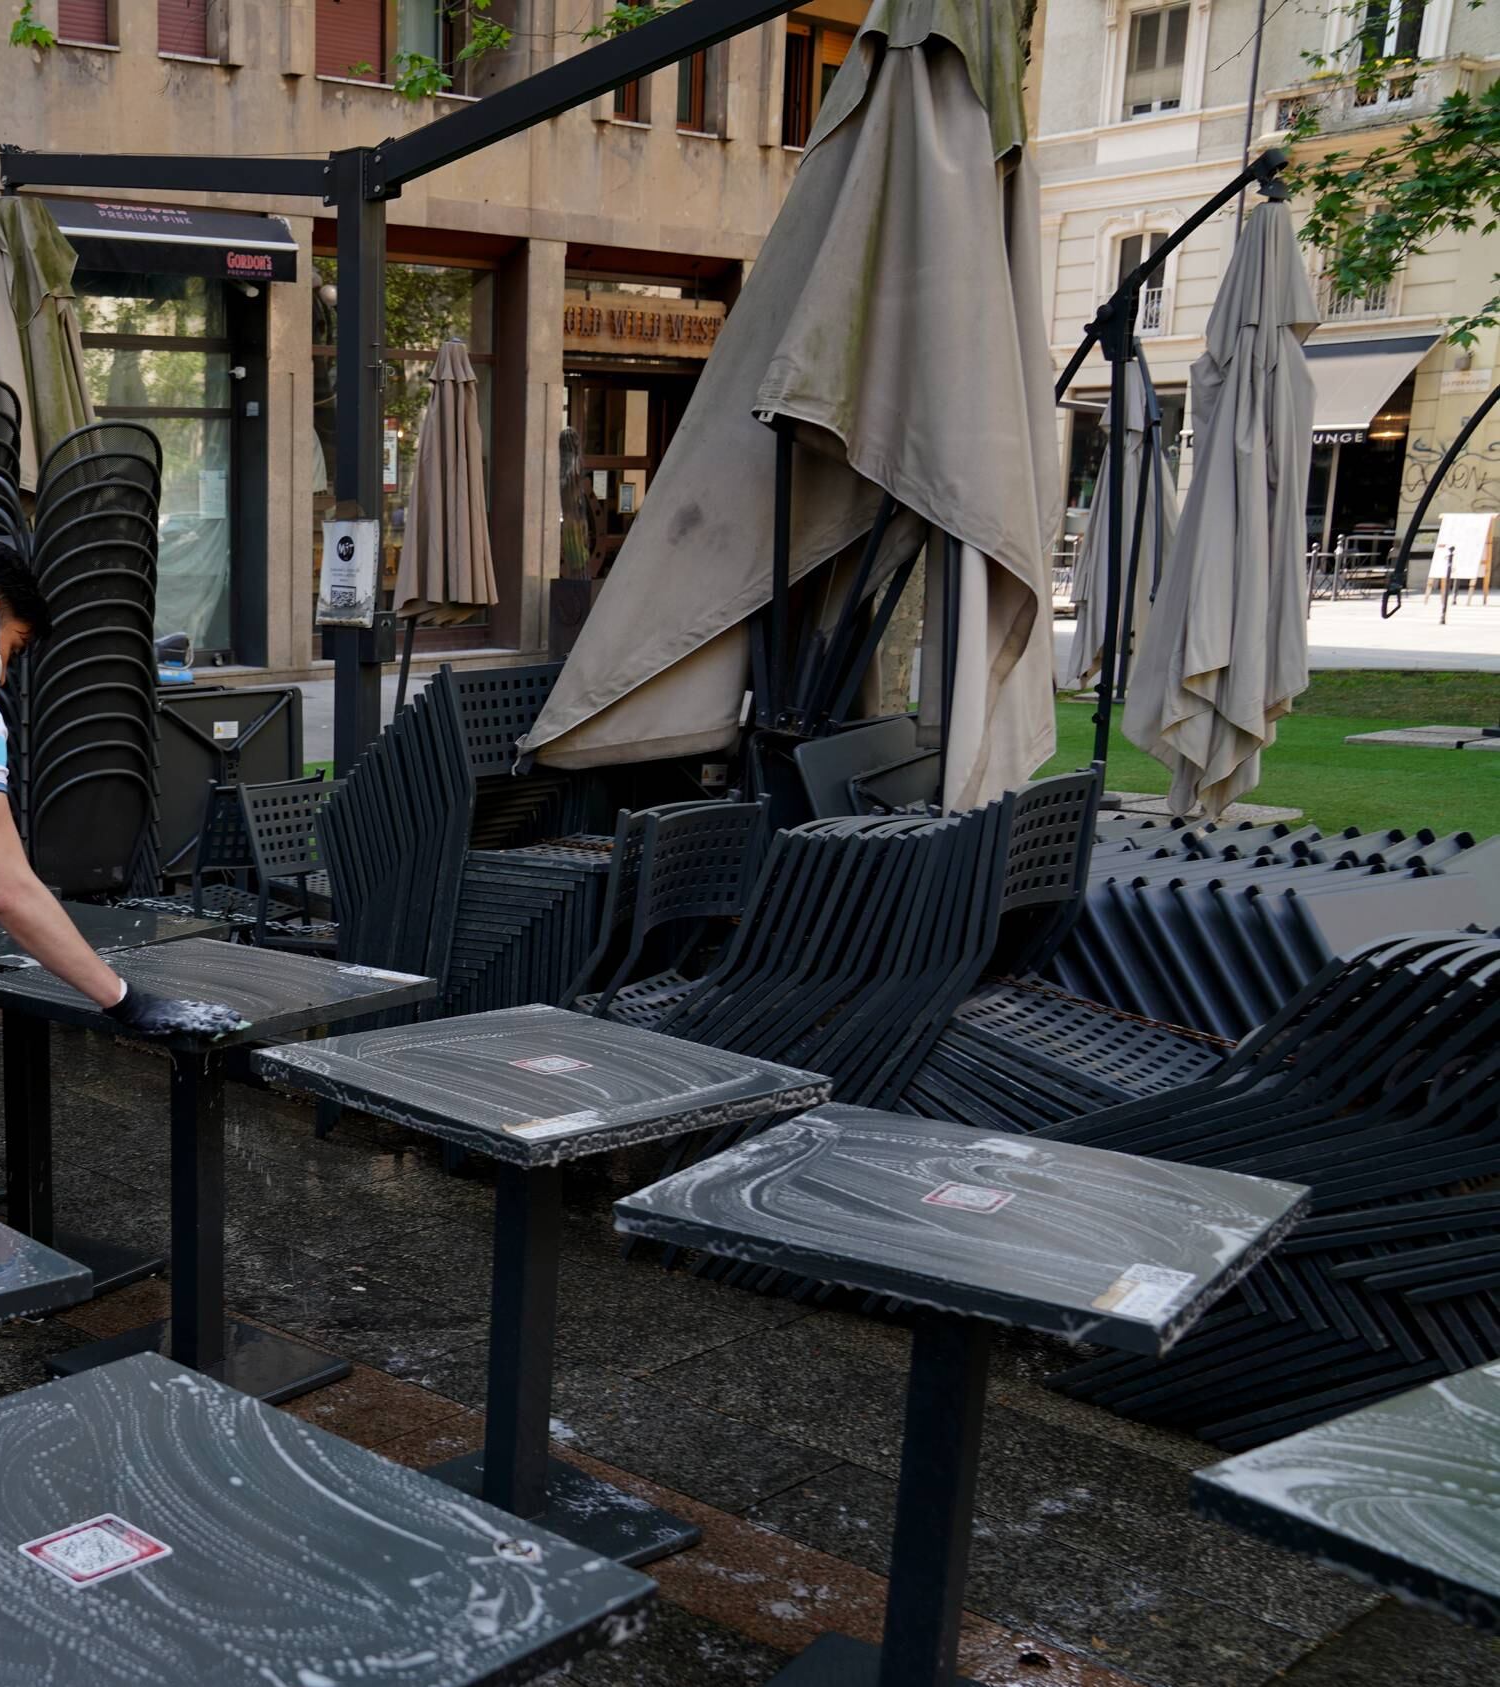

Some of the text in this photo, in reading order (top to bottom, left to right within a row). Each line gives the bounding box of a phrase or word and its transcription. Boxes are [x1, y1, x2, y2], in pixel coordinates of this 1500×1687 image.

[98, 210, 194, 226] PREMIUM PINK
[564, 306, 722, 345] OLD WILD WEST
